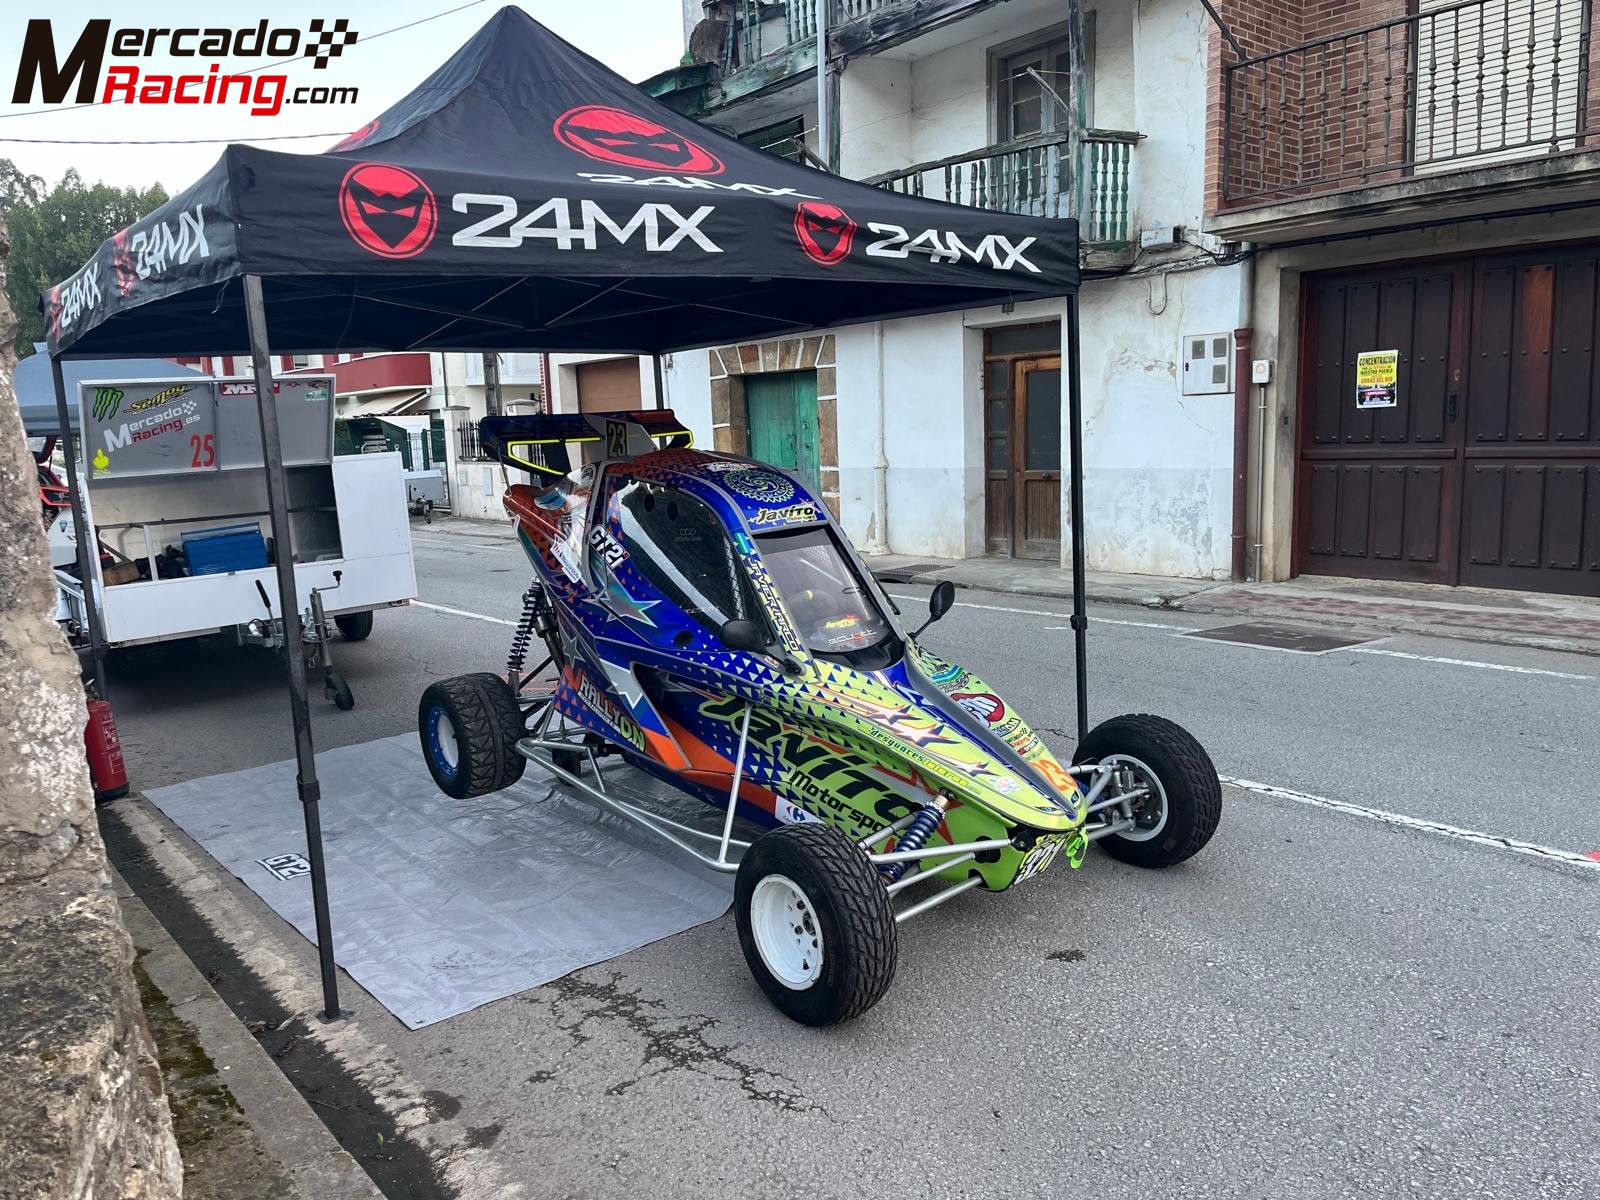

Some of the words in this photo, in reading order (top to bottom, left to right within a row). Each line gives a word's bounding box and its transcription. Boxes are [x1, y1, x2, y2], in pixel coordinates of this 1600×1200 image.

[577, 173, 824, 200] 24MX
[131, 203, 210, 281] 24MX
[452, 192, 725, 253] 24MX
[864, 221, 1043, 273] 24MX
[104, 406, 183, 453] Mercado
[190, 434, 215, 468] 25
[608, 423, 626, 457] 23
[590, 524, 630, 570] GT2i
